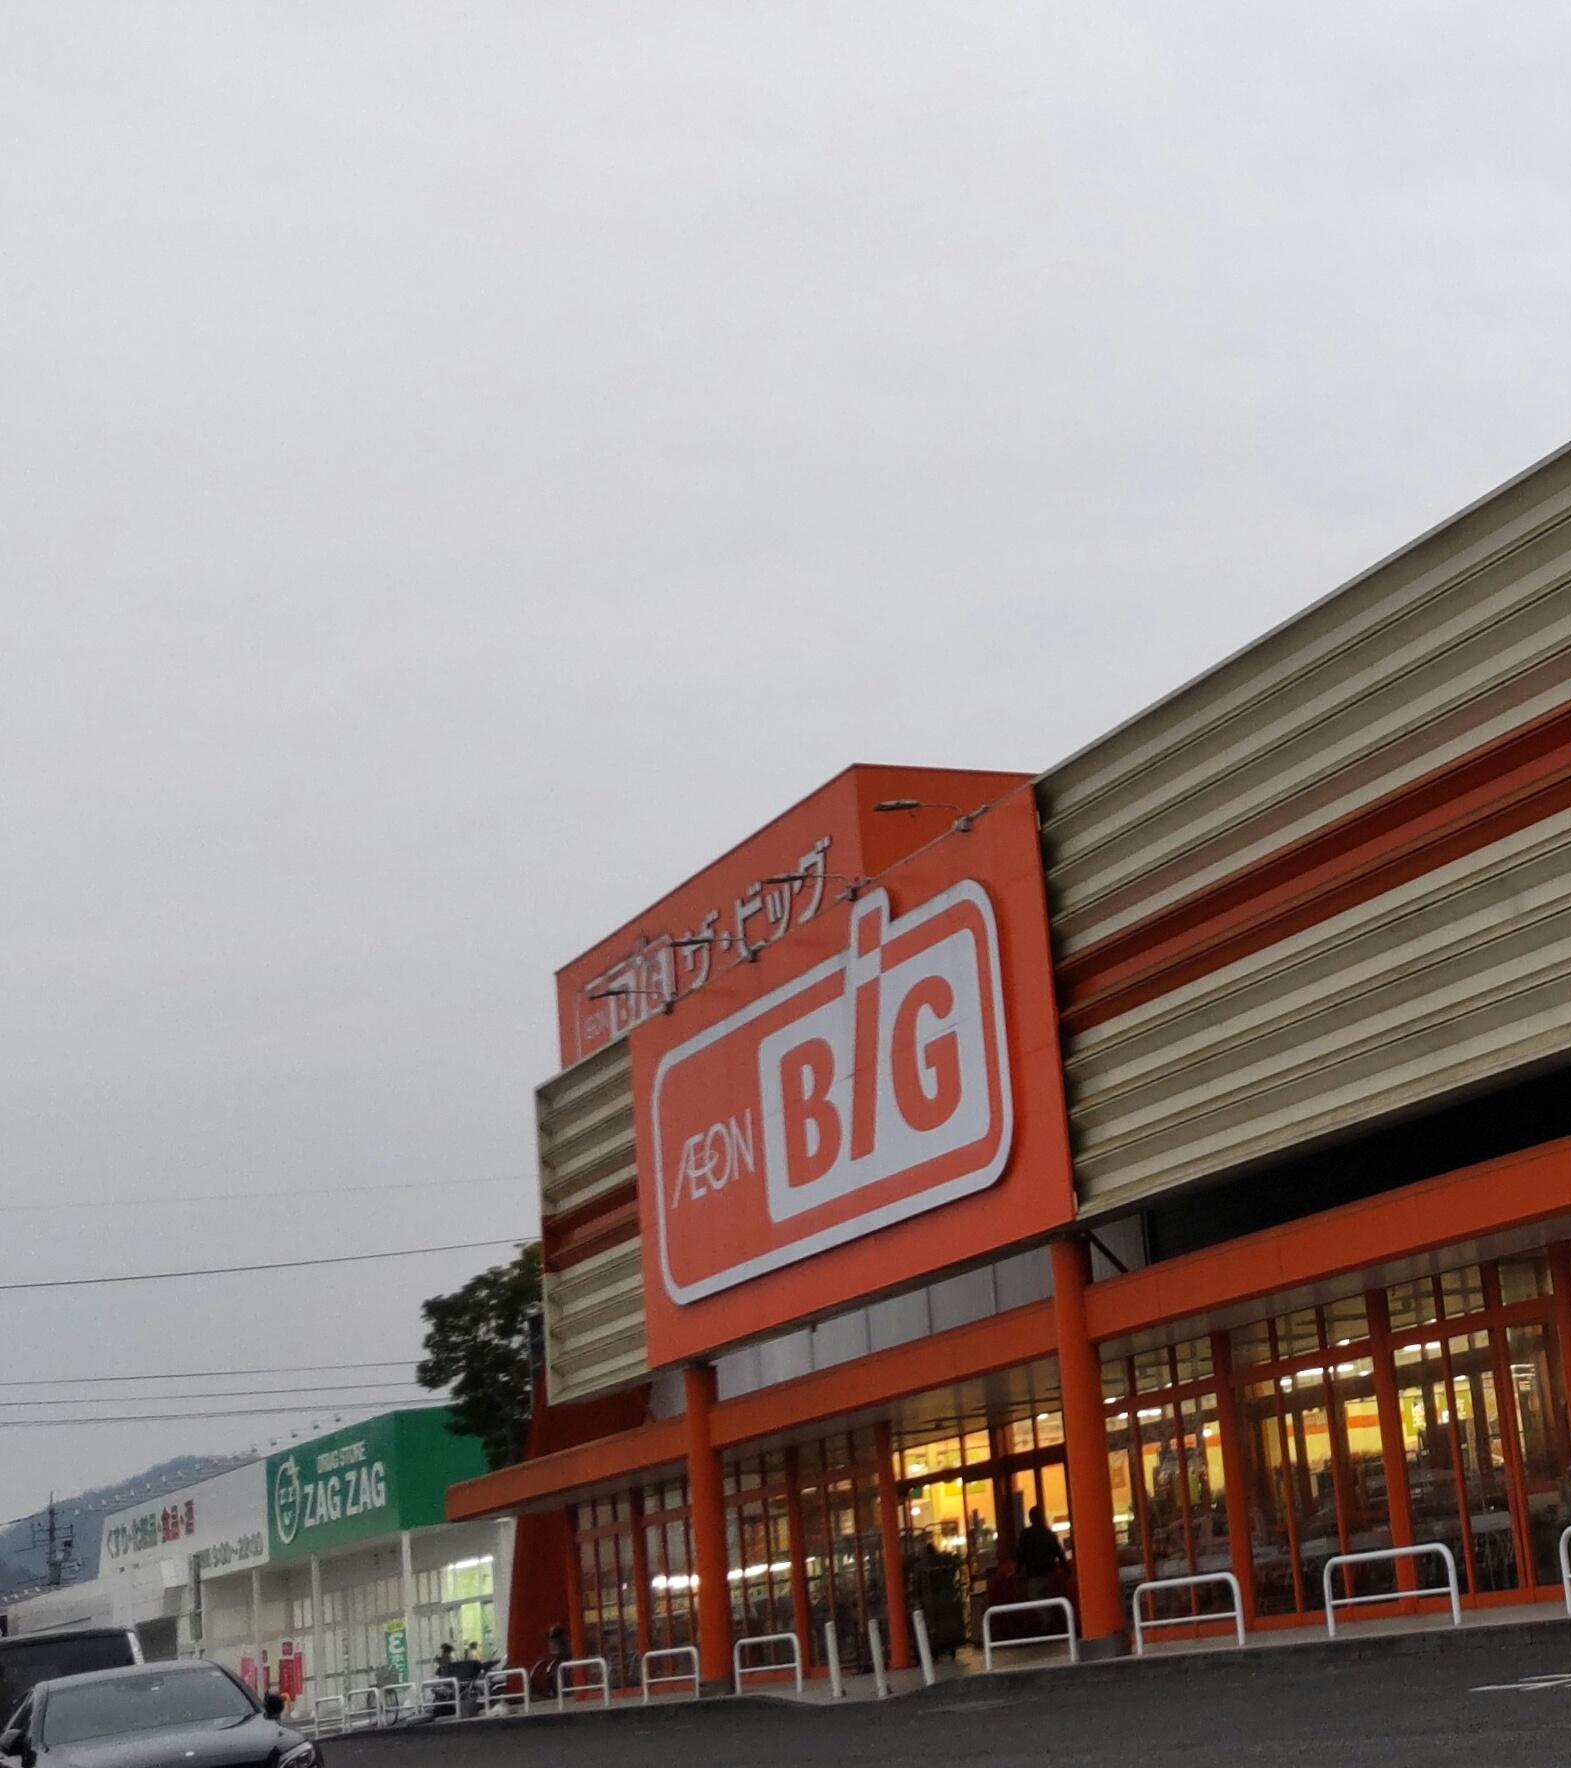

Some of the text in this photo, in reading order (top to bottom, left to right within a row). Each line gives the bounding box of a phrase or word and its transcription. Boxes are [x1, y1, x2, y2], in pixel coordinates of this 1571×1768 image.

[779, 906, 963, 1190] BIG
[303, 1461, 387, 1529] ZAG ZAG
